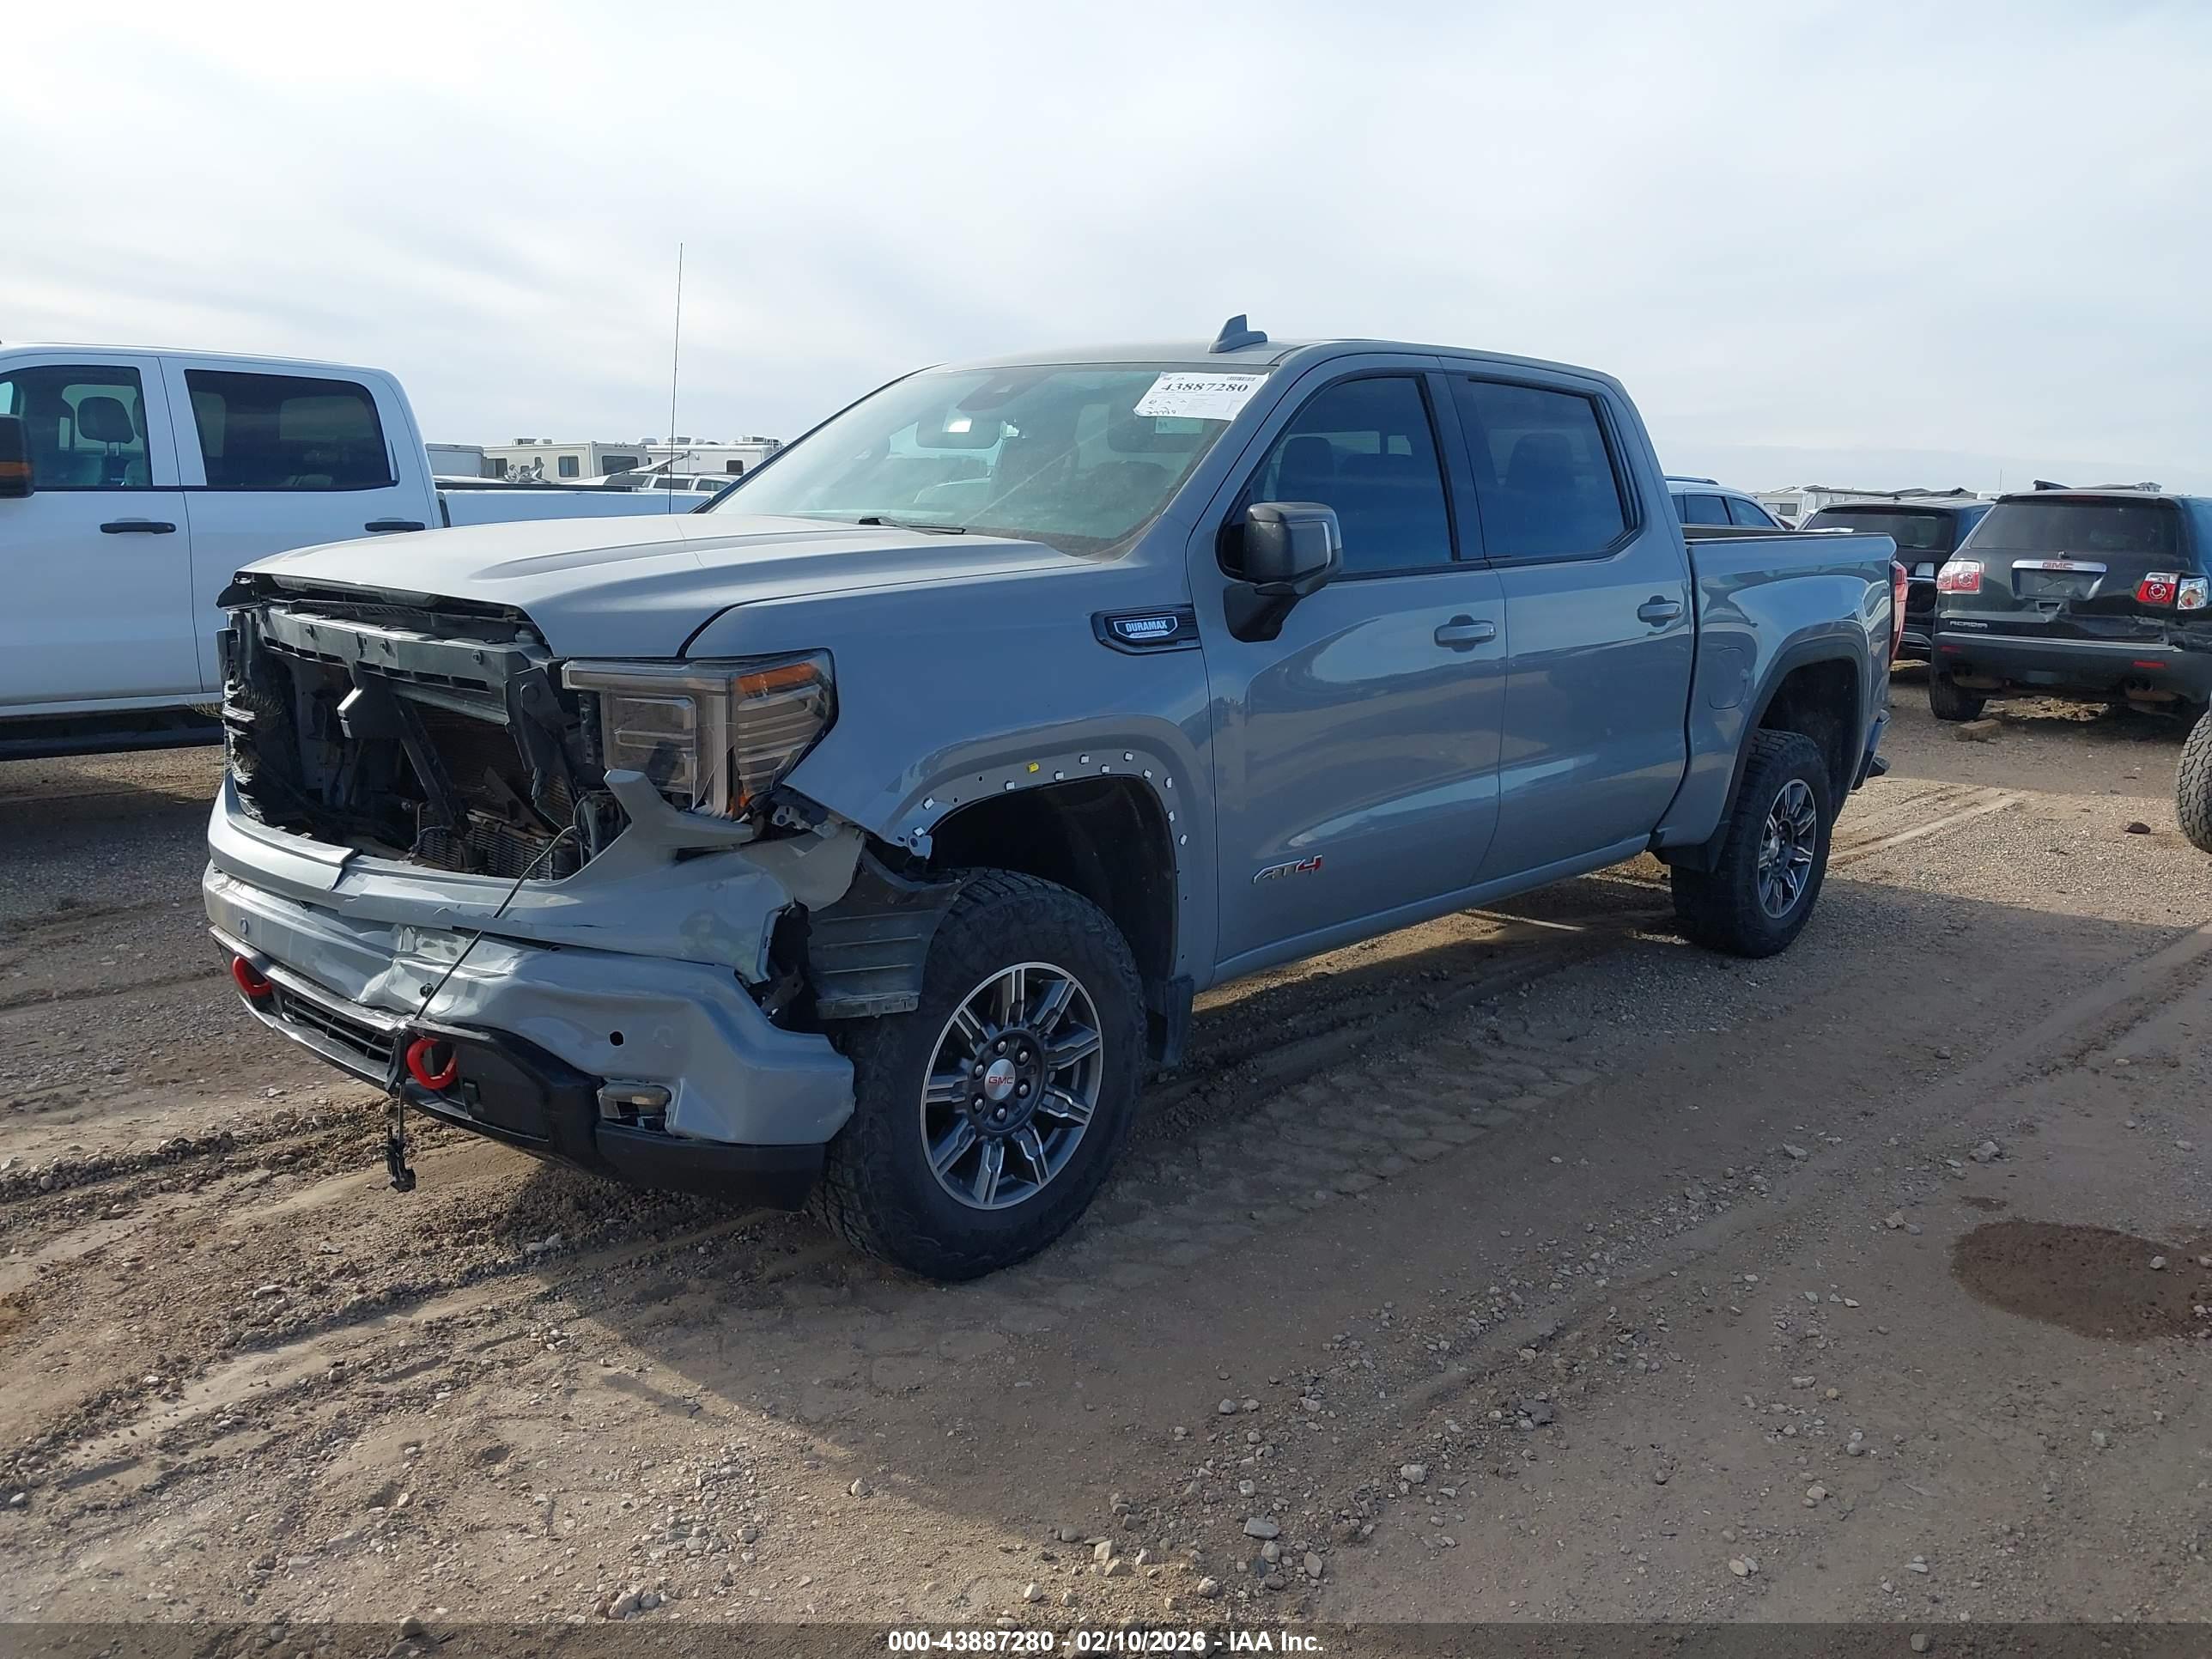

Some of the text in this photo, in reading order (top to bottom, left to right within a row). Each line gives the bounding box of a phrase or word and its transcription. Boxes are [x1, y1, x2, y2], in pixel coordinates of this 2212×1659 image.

[1161, 383, 1249, 392] 43887280
[2042, 562, 2075, 570] GMC
[1125, 620, 1168, 633] DURAMAX
[1252, 854, 1323, 884] AT4
[988, 1076, 1014, 1085] GMC
